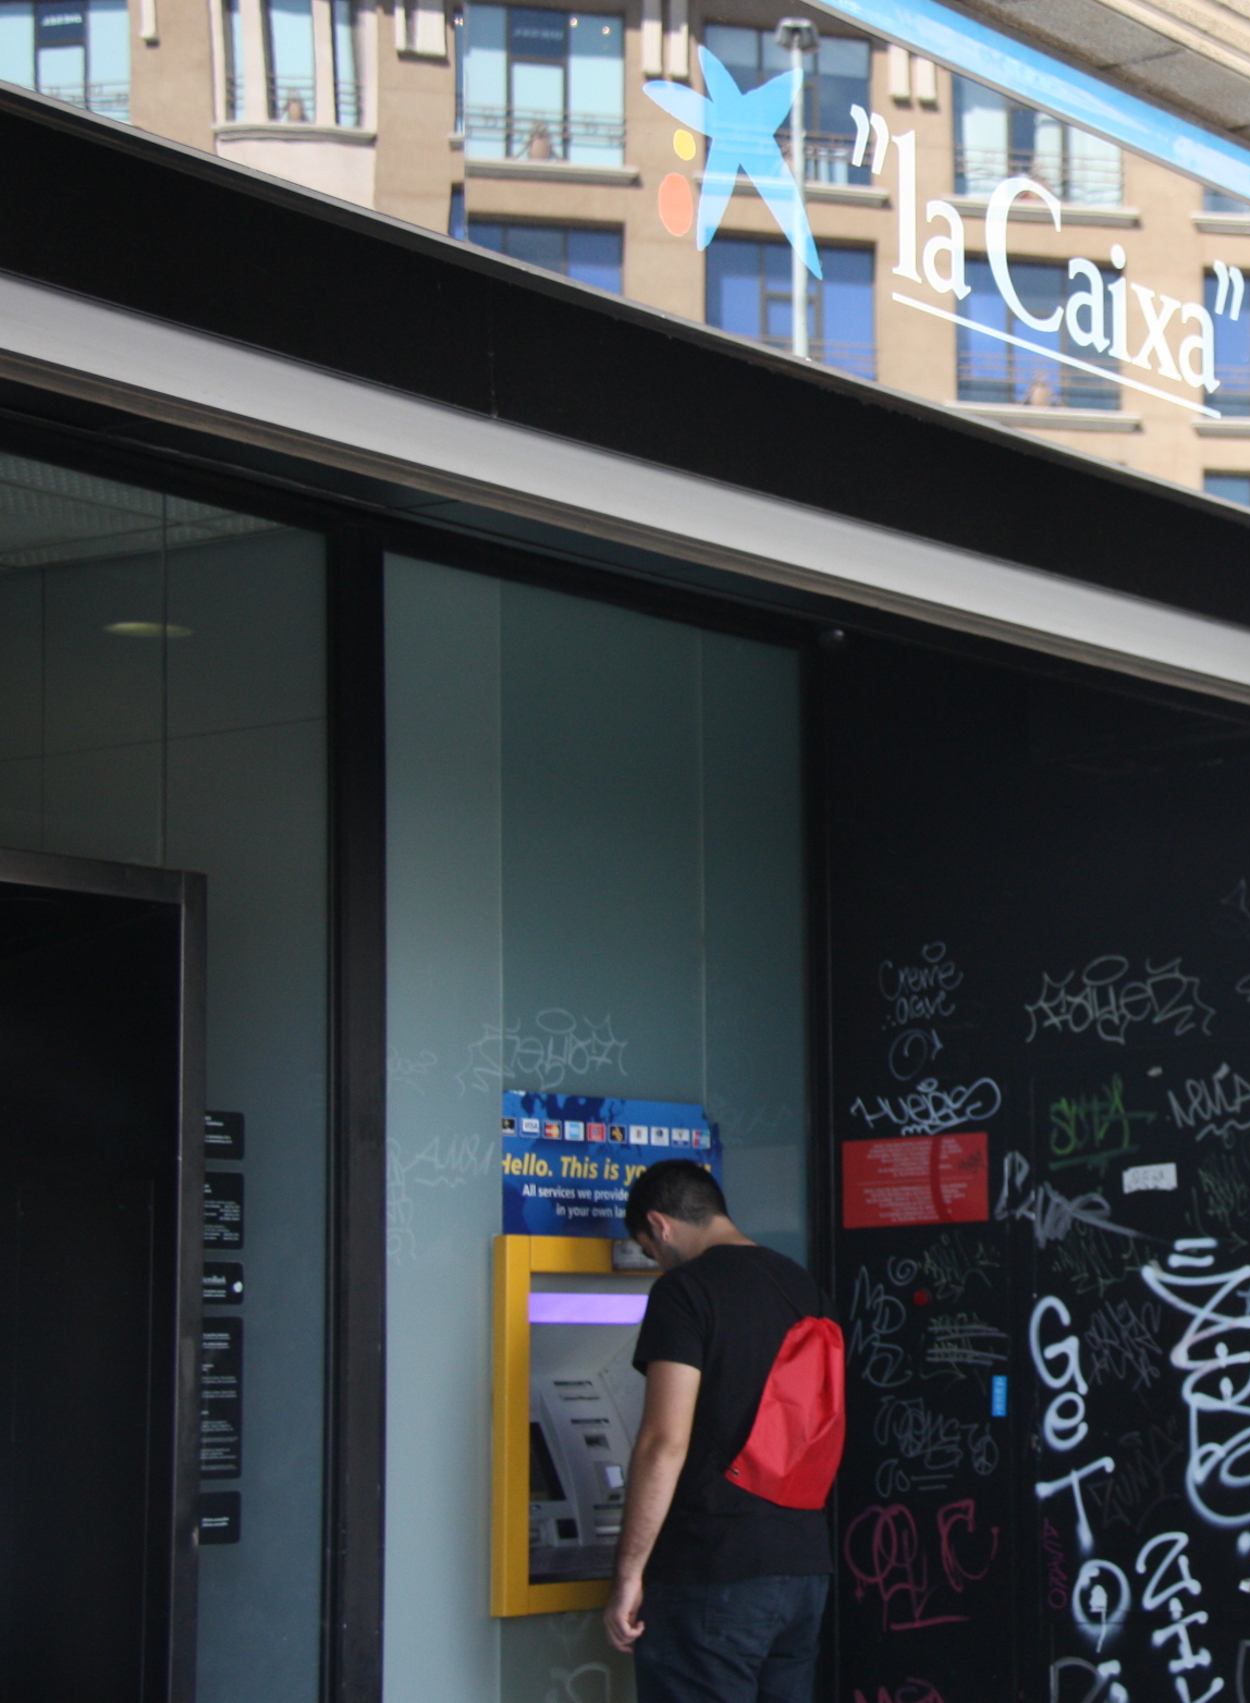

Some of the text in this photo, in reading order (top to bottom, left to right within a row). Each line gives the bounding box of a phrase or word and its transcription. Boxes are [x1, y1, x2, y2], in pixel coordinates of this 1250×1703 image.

[560, 1156, 599, 1179] This
[604, 1158, 620, 1180] is
[522, 1184, 536, 1196] All
[538, 1184, 575, 1198] services
[577, 1188, 592, 1199] we
[556, 1204, 566, 1215] in
[568, 1206, 589, 1219] your
[592, 1207, 612, 1216] own
